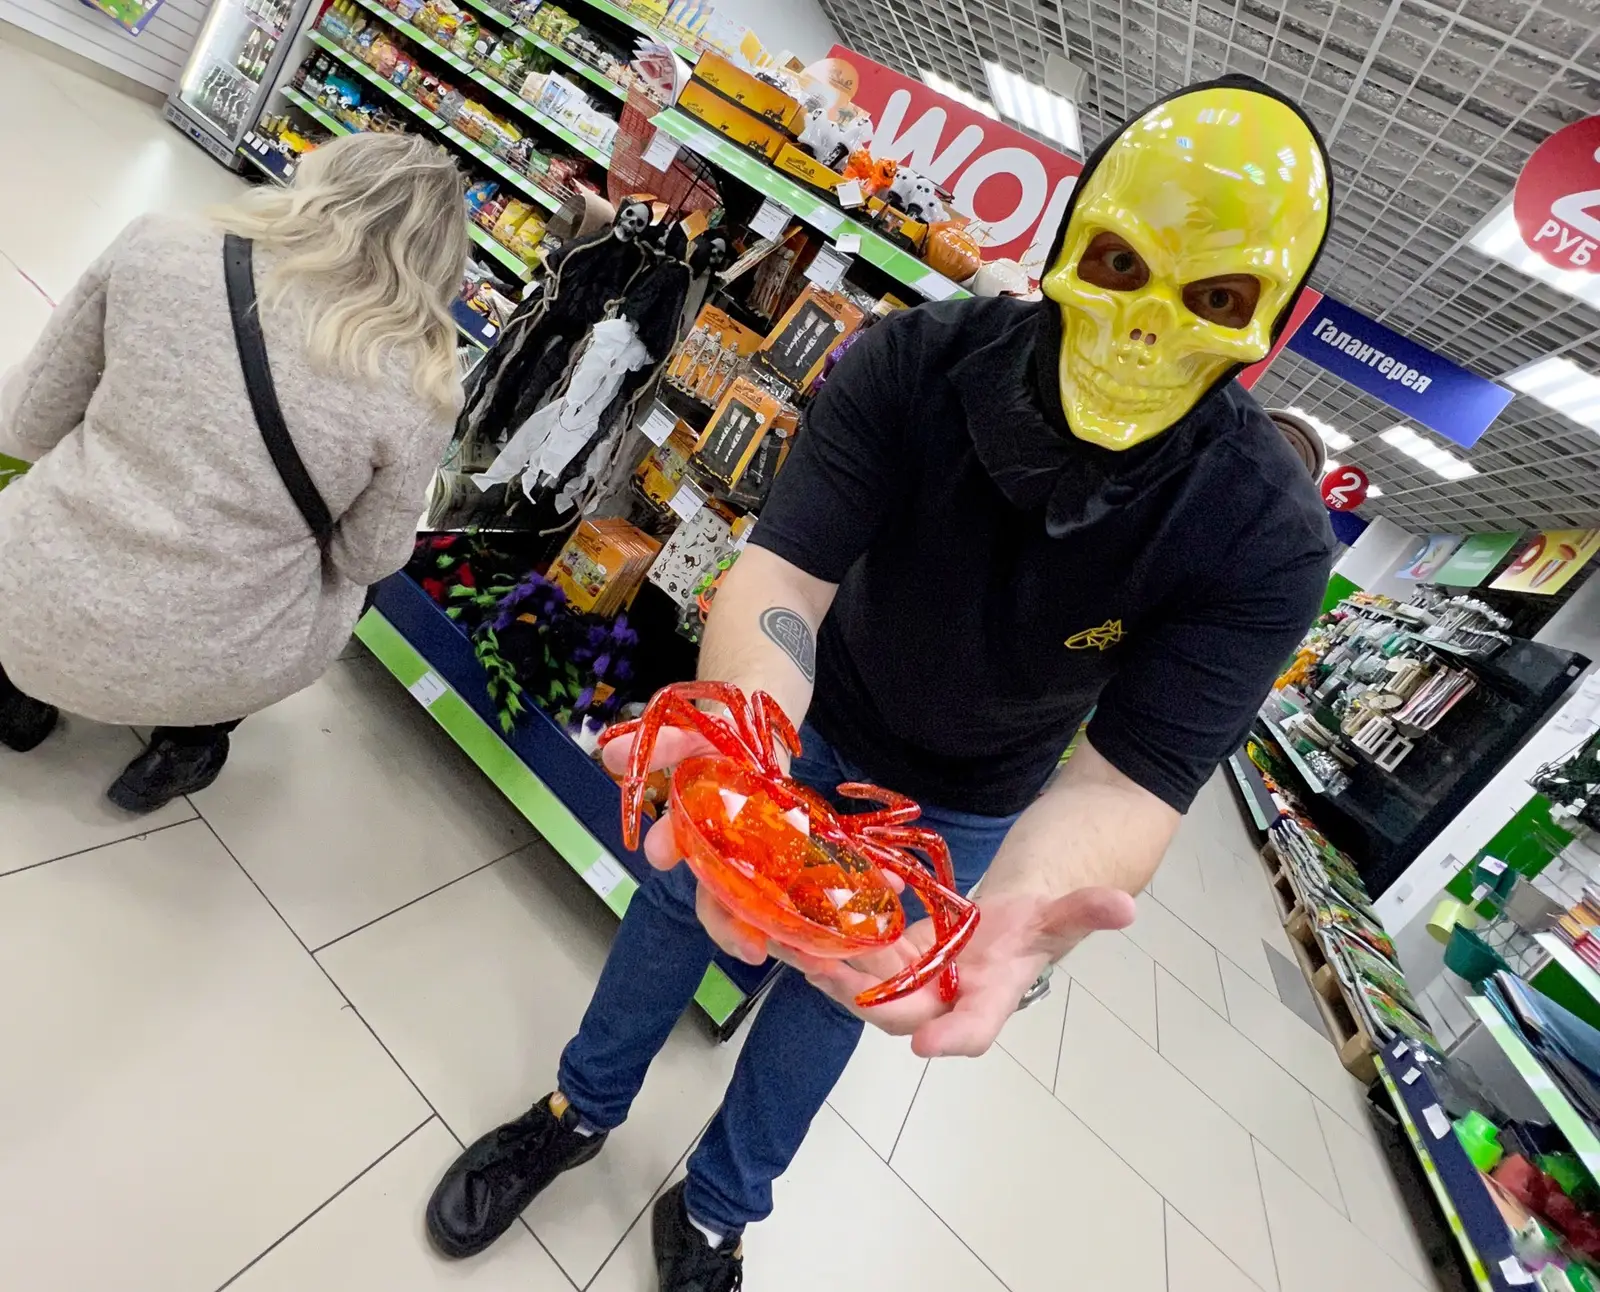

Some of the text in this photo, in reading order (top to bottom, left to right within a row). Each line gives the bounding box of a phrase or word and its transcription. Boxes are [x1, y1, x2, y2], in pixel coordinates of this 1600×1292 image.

[1532, 218, 1599, 266] РУБ
[1312, 317, 1433, 394] Галантерея
[1325, 493, 1344, 509] РУБ
[1330, 472, 1362, 503] 2
